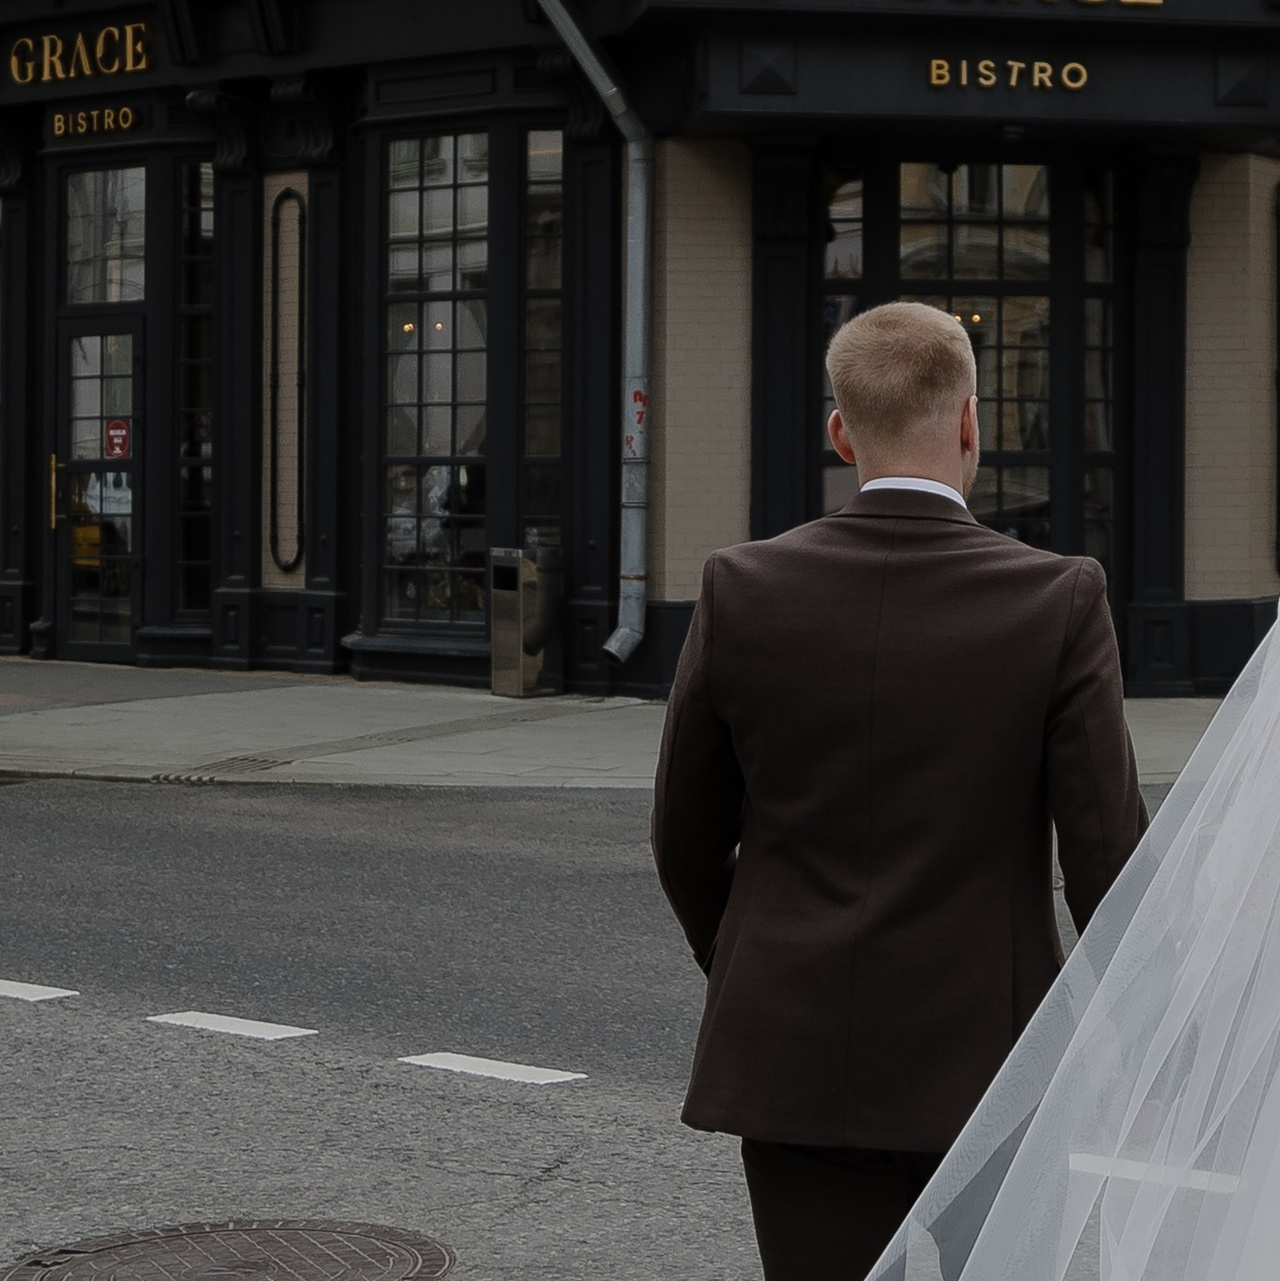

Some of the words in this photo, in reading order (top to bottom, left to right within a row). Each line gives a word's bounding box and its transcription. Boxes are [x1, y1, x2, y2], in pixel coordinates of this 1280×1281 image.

[11, 23, 147, 83] GRACE
[930, 59, 1088, 89] BISTRO
[54, 107, 133, 136] BISTRO
